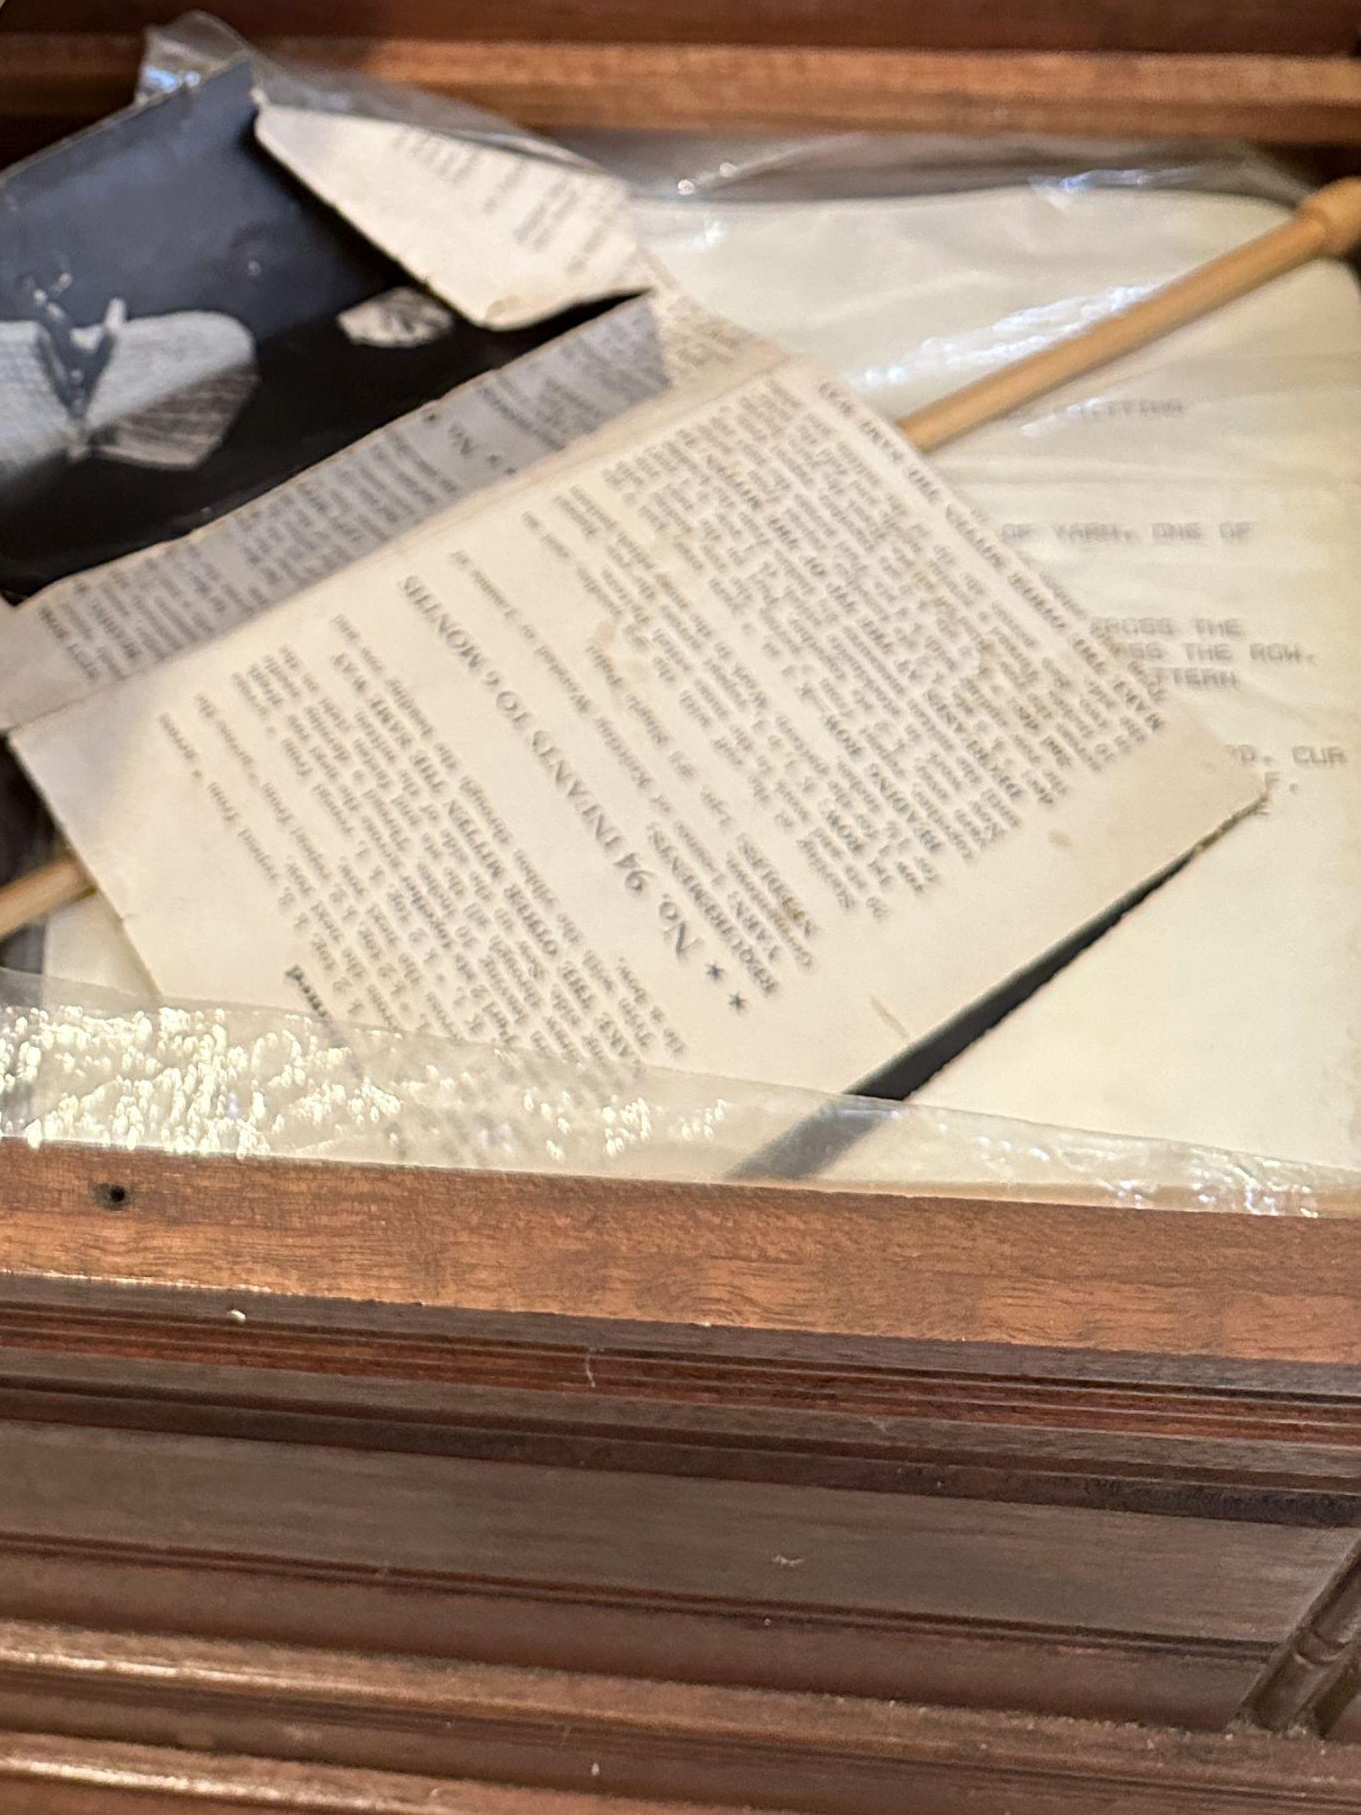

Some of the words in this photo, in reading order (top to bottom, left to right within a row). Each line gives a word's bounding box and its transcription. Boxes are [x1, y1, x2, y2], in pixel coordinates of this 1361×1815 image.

[1152, 521, 1203, 542] ONE
[1219, 521, 1253, 542] OF
[390, 568, 495, 677] MONTHS
[1184, 642, 1234, 662] THE
[1193, 618, 1245, 638] THE
[487, 680, 538, 735] TO
[519, 723, 631, 863] INFANTS
[442, 797, 507, 880] MITTEN
[607, 845, 659, 900] 94
[396, 871, 458, 954] together
[501, 880, 562, 960] OTHER
[640, 889, 707, 962] No.
[554, 958, 598, 1012] THE
